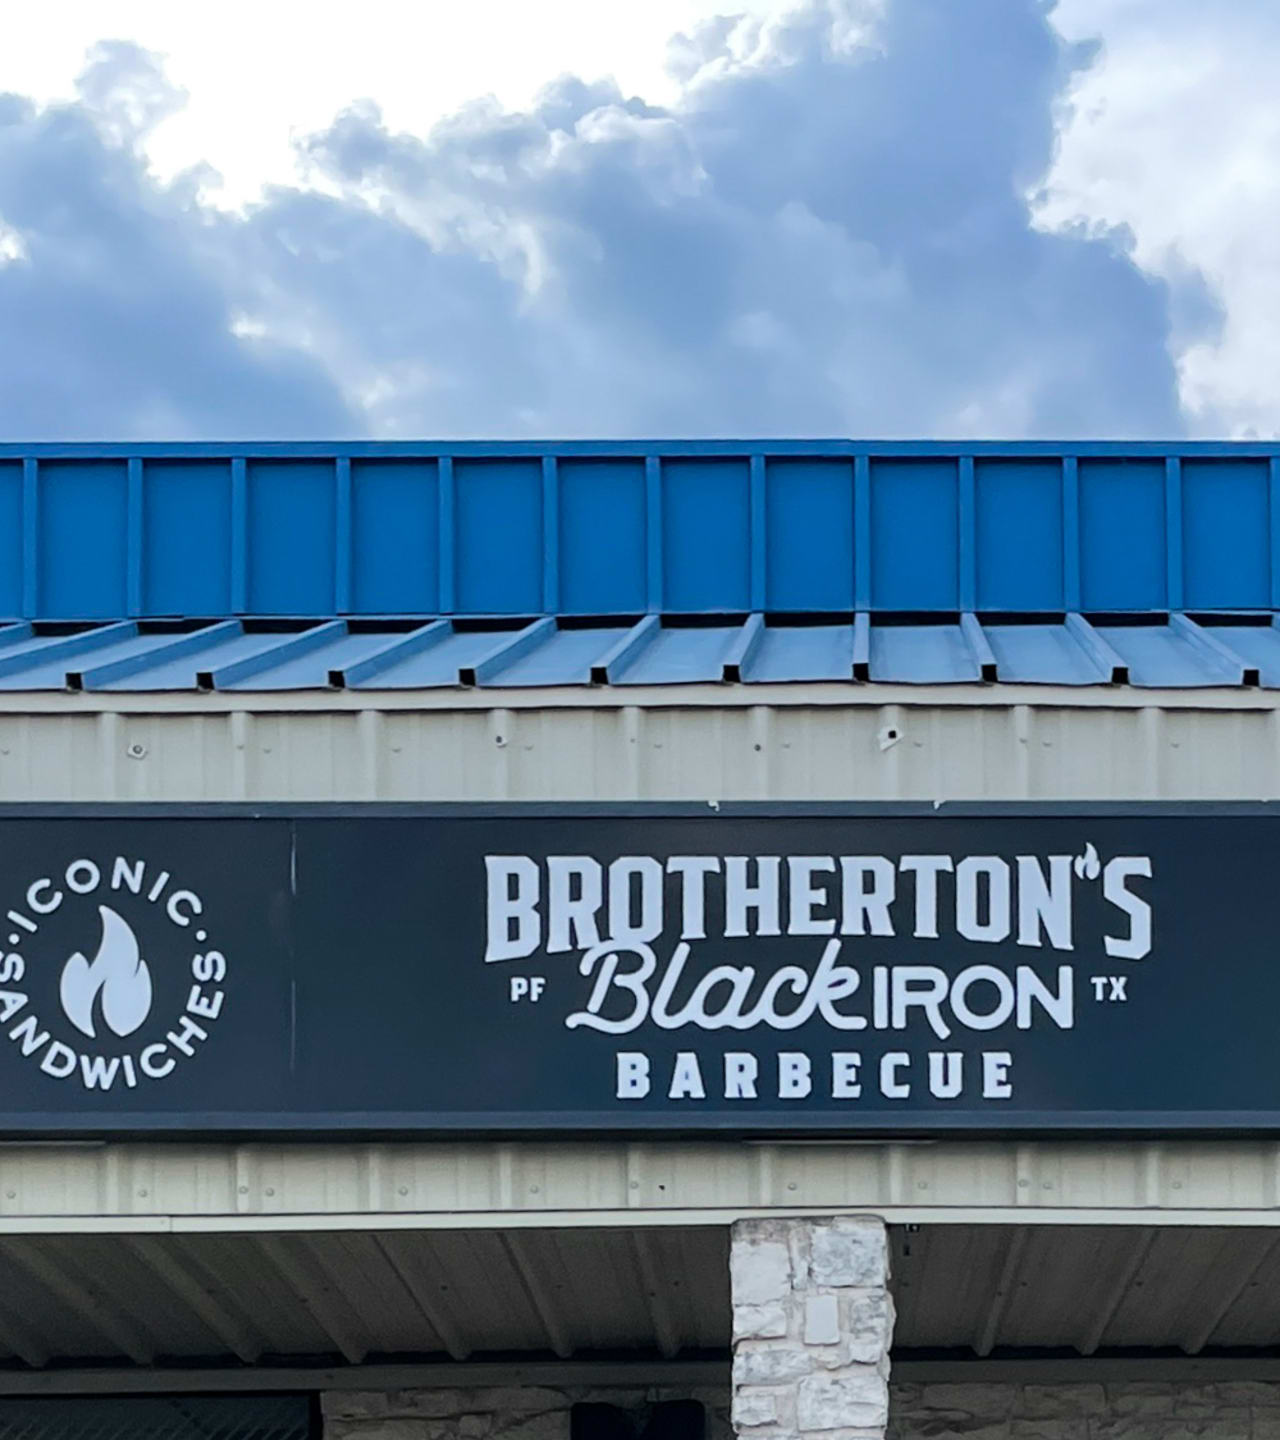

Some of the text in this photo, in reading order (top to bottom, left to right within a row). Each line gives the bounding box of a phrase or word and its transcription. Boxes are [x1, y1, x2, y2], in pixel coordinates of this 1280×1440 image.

[7, 856, 203, 933] ICONIC
[510, 977, 546, 1001] PF
[565, 938, 1074, 1040] Black IRON
[1091, 976, 1128, 1001] TX
[617, 1052, 1013, 1099] BARBECUE
